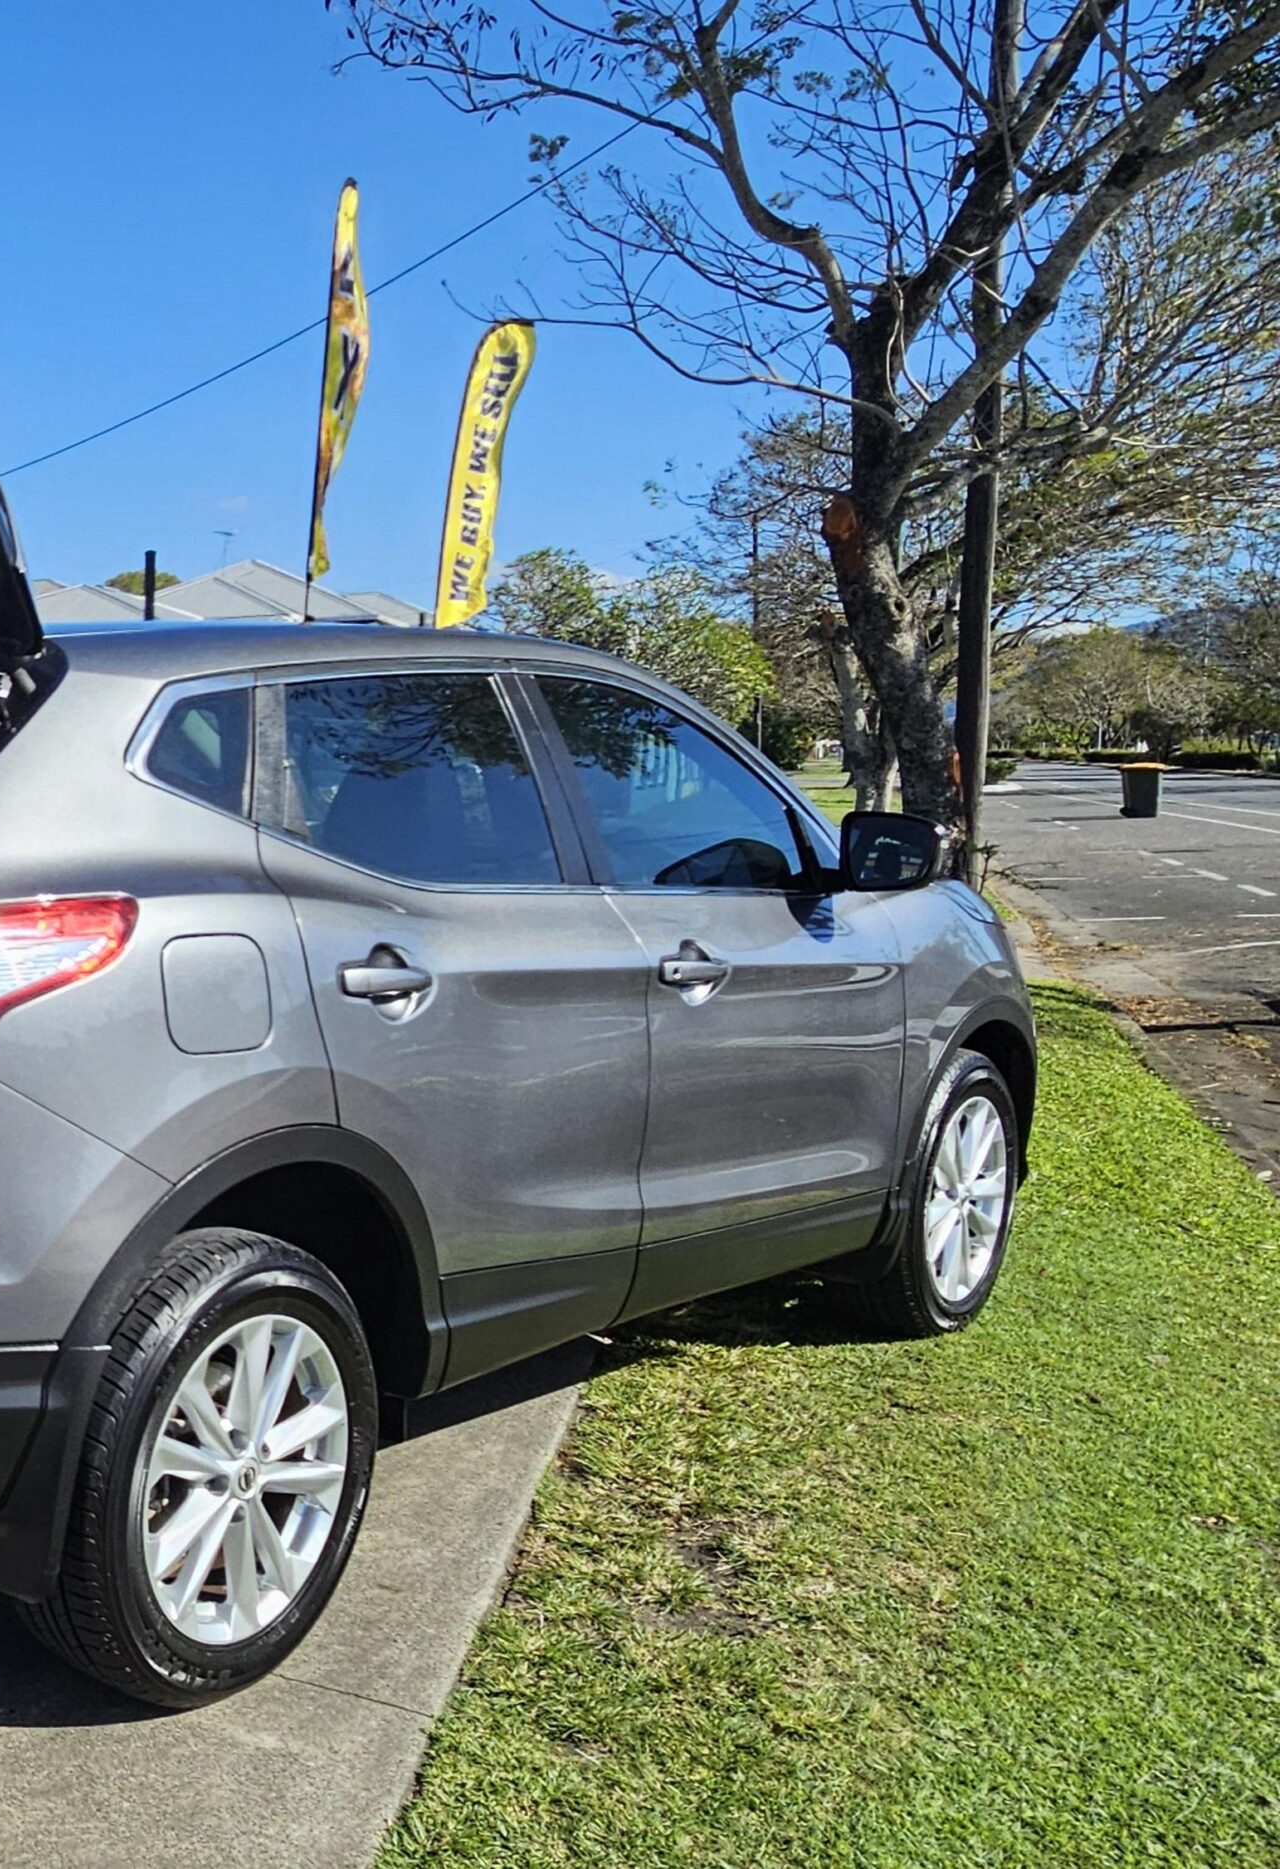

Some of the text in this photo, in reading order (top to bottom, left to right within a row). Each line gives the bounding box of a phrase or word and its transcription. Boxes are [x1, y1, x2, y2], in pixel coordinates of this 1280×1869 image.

[481, 351, 520, 419] SELL
[469, 422, 498, 474] WE
[449, 550, 475, 602] WE
